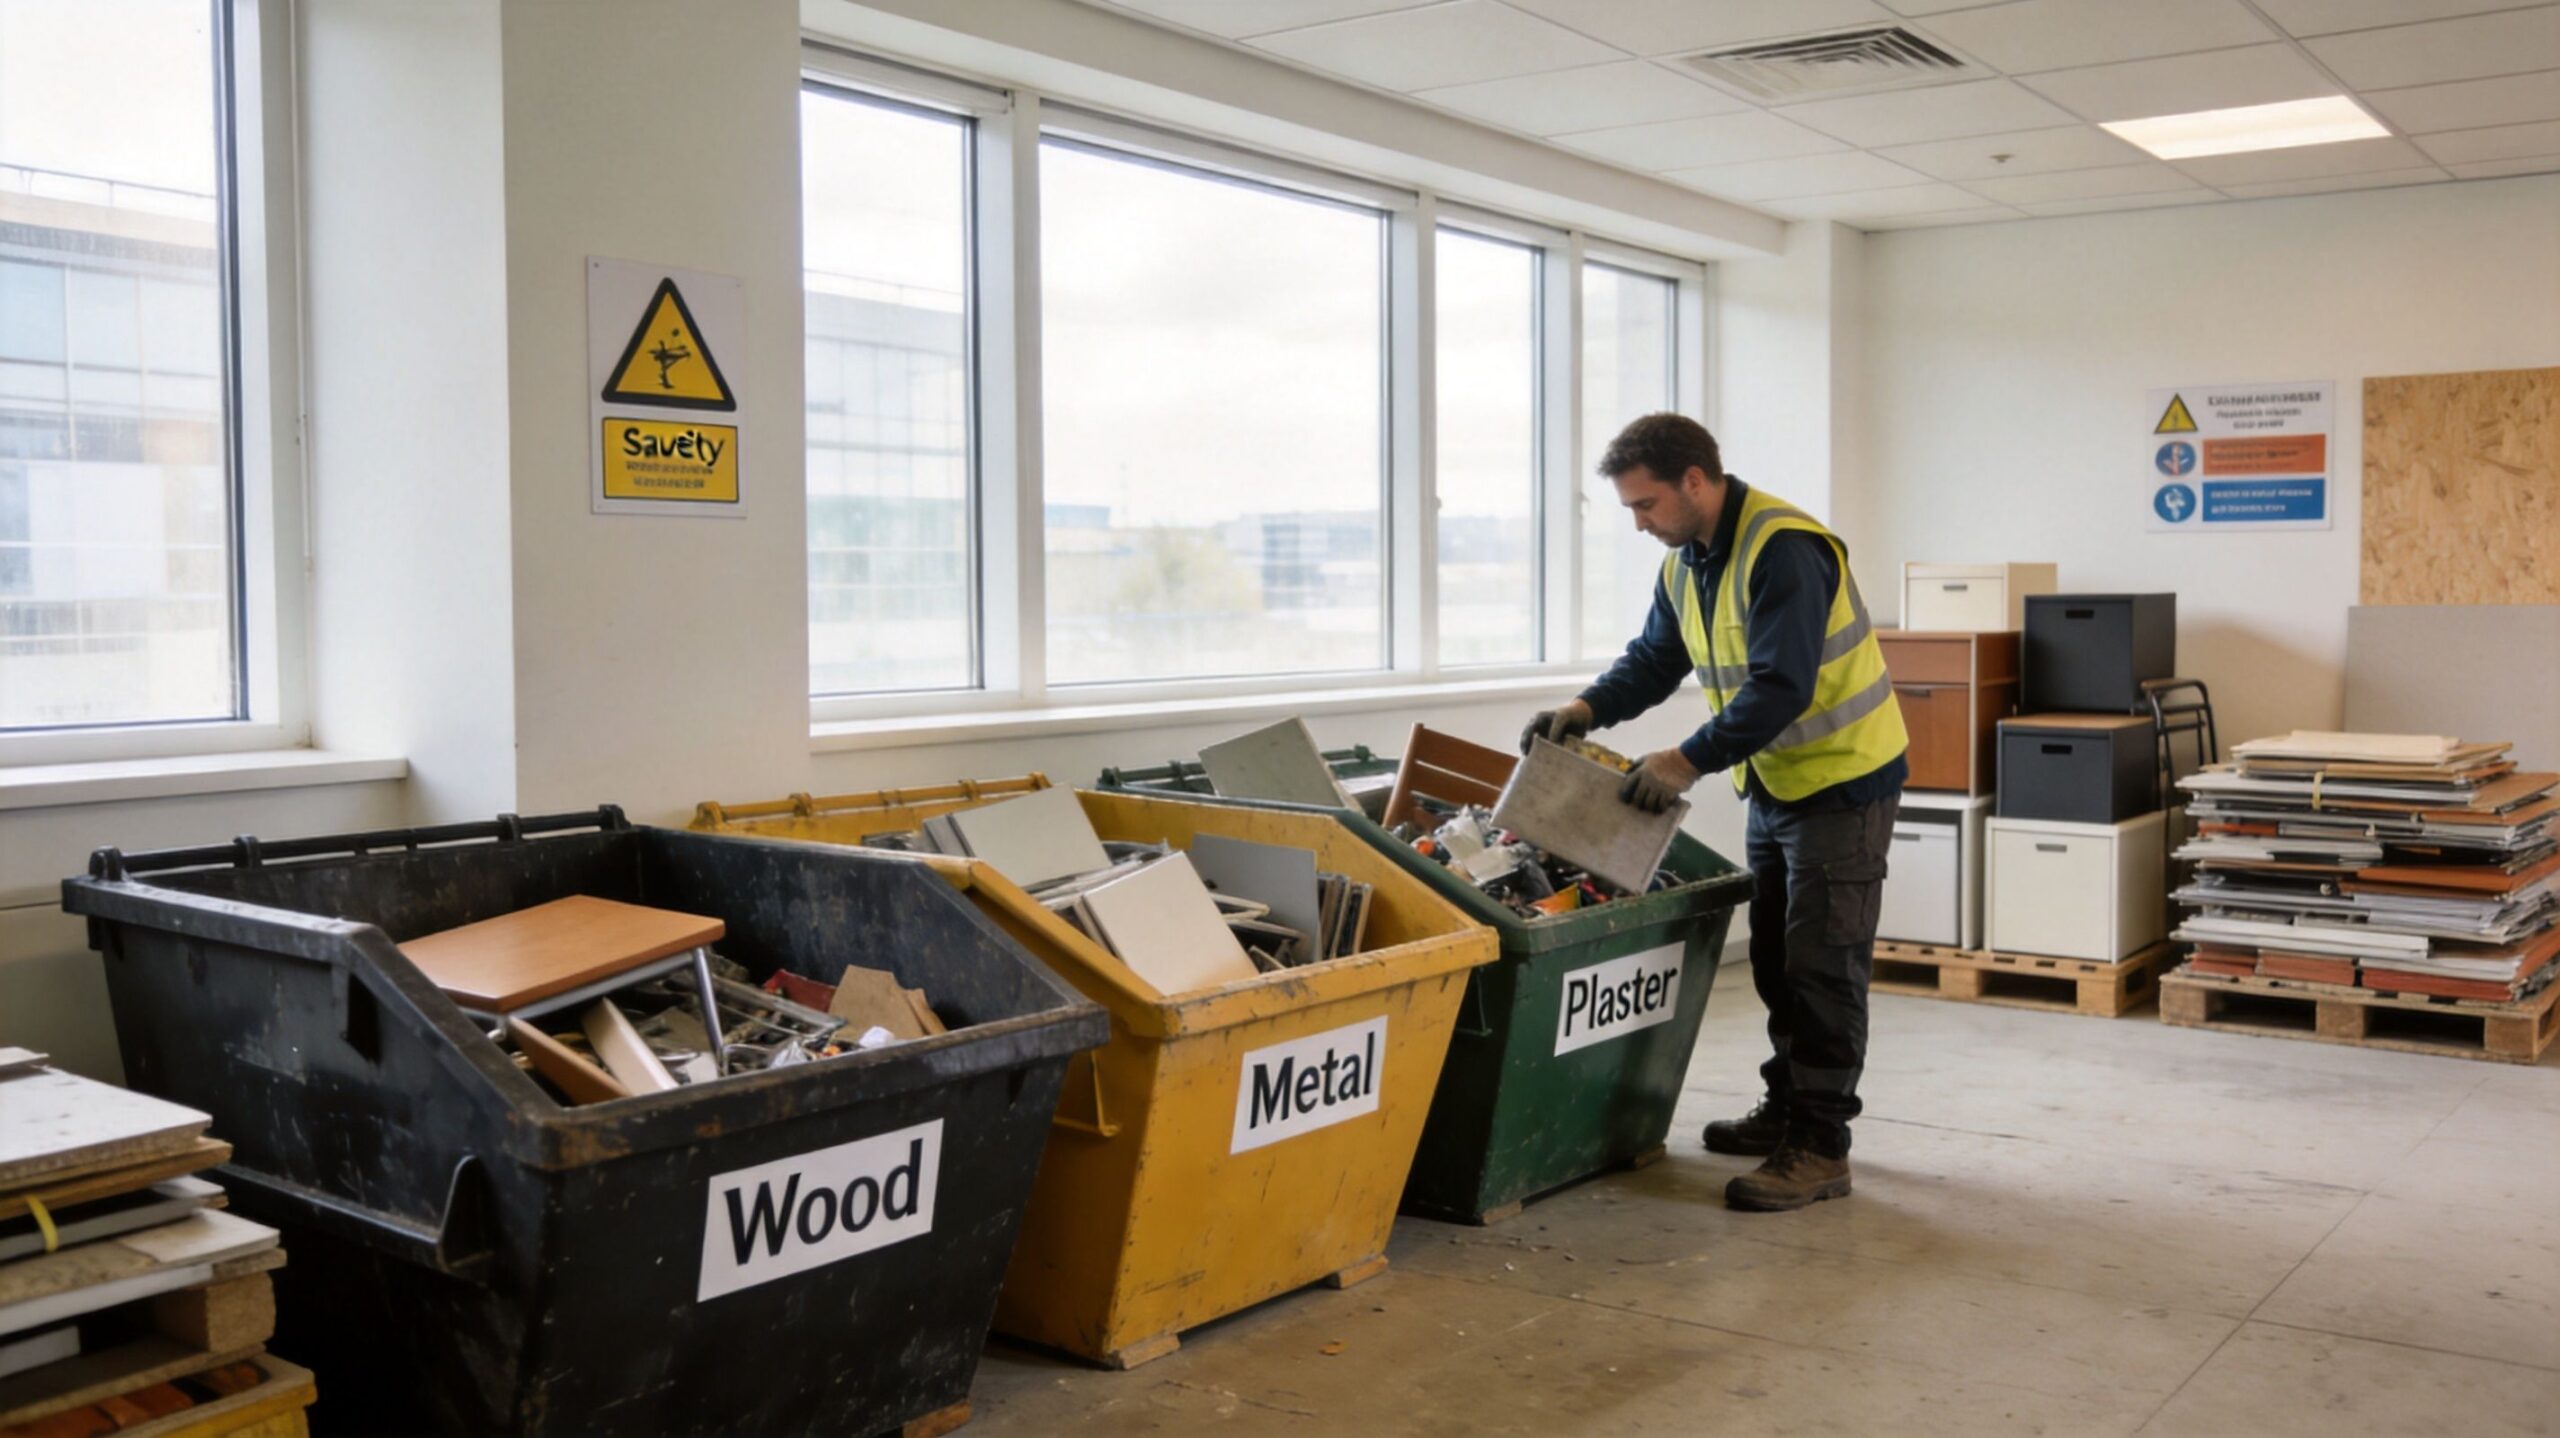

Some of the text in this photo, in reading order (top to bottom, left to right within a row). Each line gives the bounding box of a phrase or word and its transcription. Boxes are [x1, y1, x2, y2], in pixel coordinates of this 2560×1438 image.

[1565, 967, 1677, 1037] Plaster
[1250, 1031, 1375, 1130] Metal
[724, 1138, 923, 1266] Wood
